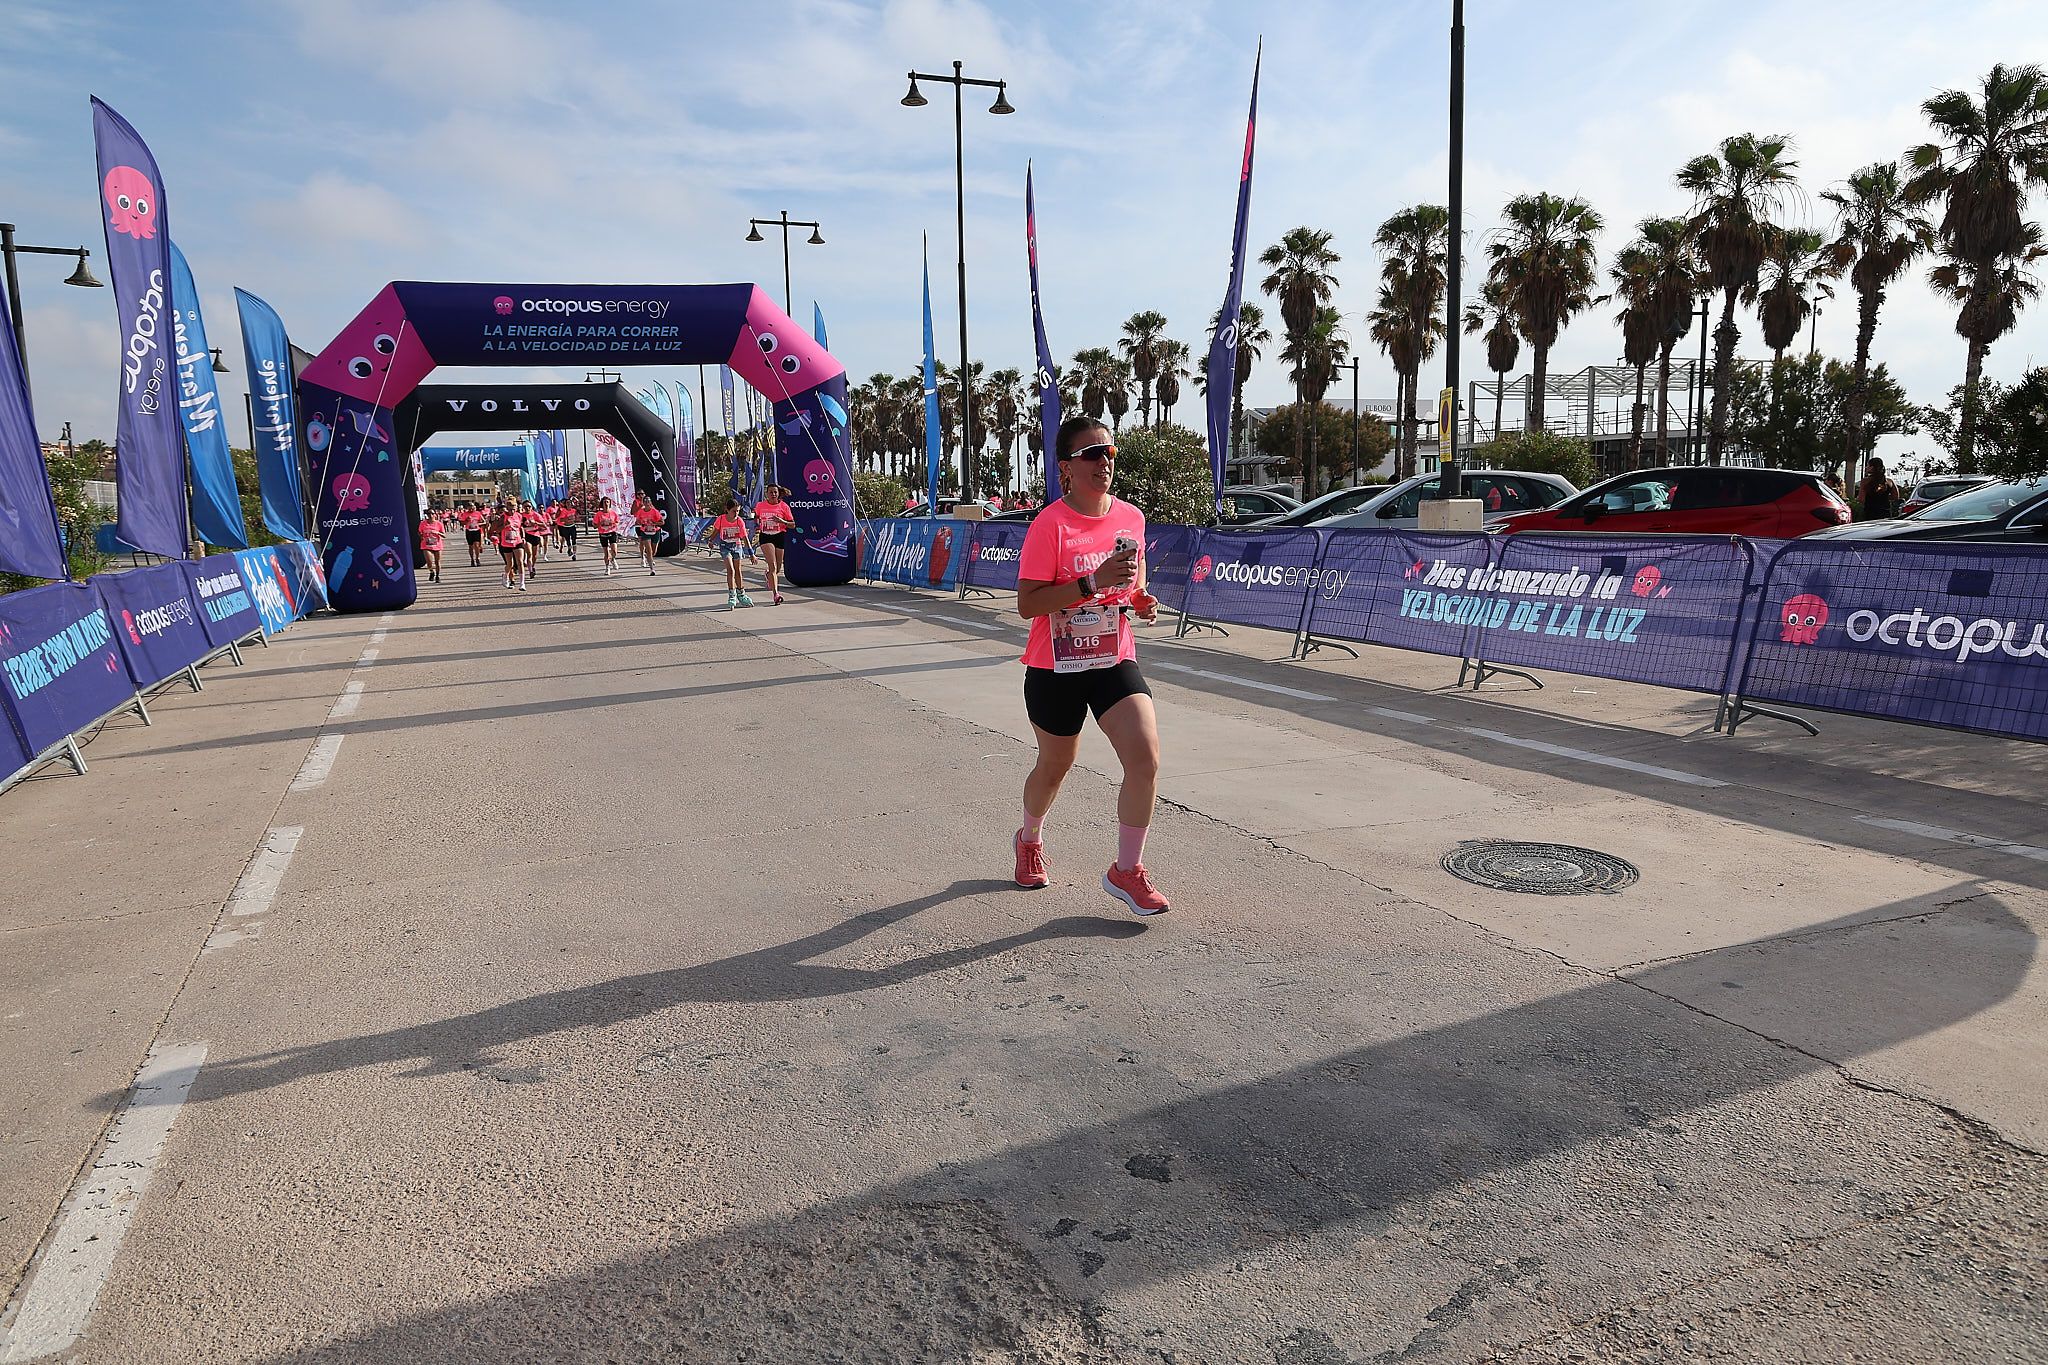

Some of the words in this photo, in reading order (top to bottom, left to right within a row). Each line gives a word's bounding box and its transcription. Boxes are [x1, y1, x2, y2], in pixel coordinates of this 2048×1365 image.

[521, 298, 603, 317] octopus
[605, 300, 670, 319] energy
[483, 324, 503, 336] LA
[507, 323, 573, 337] ENERGÍA
[577, 326, 617, 337] PARA
[621, 326, 679, 337] CORRER
[483, 341, 494, 351] A
[498, 341, 517, 351] LA
[521, 341, 606, 351] VELOCIDAD
[610, 341, 629, 351] DE
[632, 341, 651, 351] LA
[655, 341, 683, 351] LUZ
[446, 398, 591, 412] VOLVO
[455, 449, 500, 468] Marlene
[789, 500, 824, 510] octopus
[322, 518, 359, 529] octopus
[359, 515, 393, 526] energy
[980, 546, 1013, 565] octopus
[1215, 559, 1284, 590] octopus
[1284, 566, 1350, 600] energy
[1423, 559, 1467, 590] Has
[1466, 562, 1591, 598] alcanzado
[1591, 567, 1624, 600] la
[1400, 589, 1511, 629] VELOCIDAD
[1508, 600, 1547, 634] DE
[1544, 603, 1587, 638] LA
[1585, 606, 1647, 643] LUZ
[1073, 635, 1100, 648] 016
[1845, 607, 2048, 664] octopu
